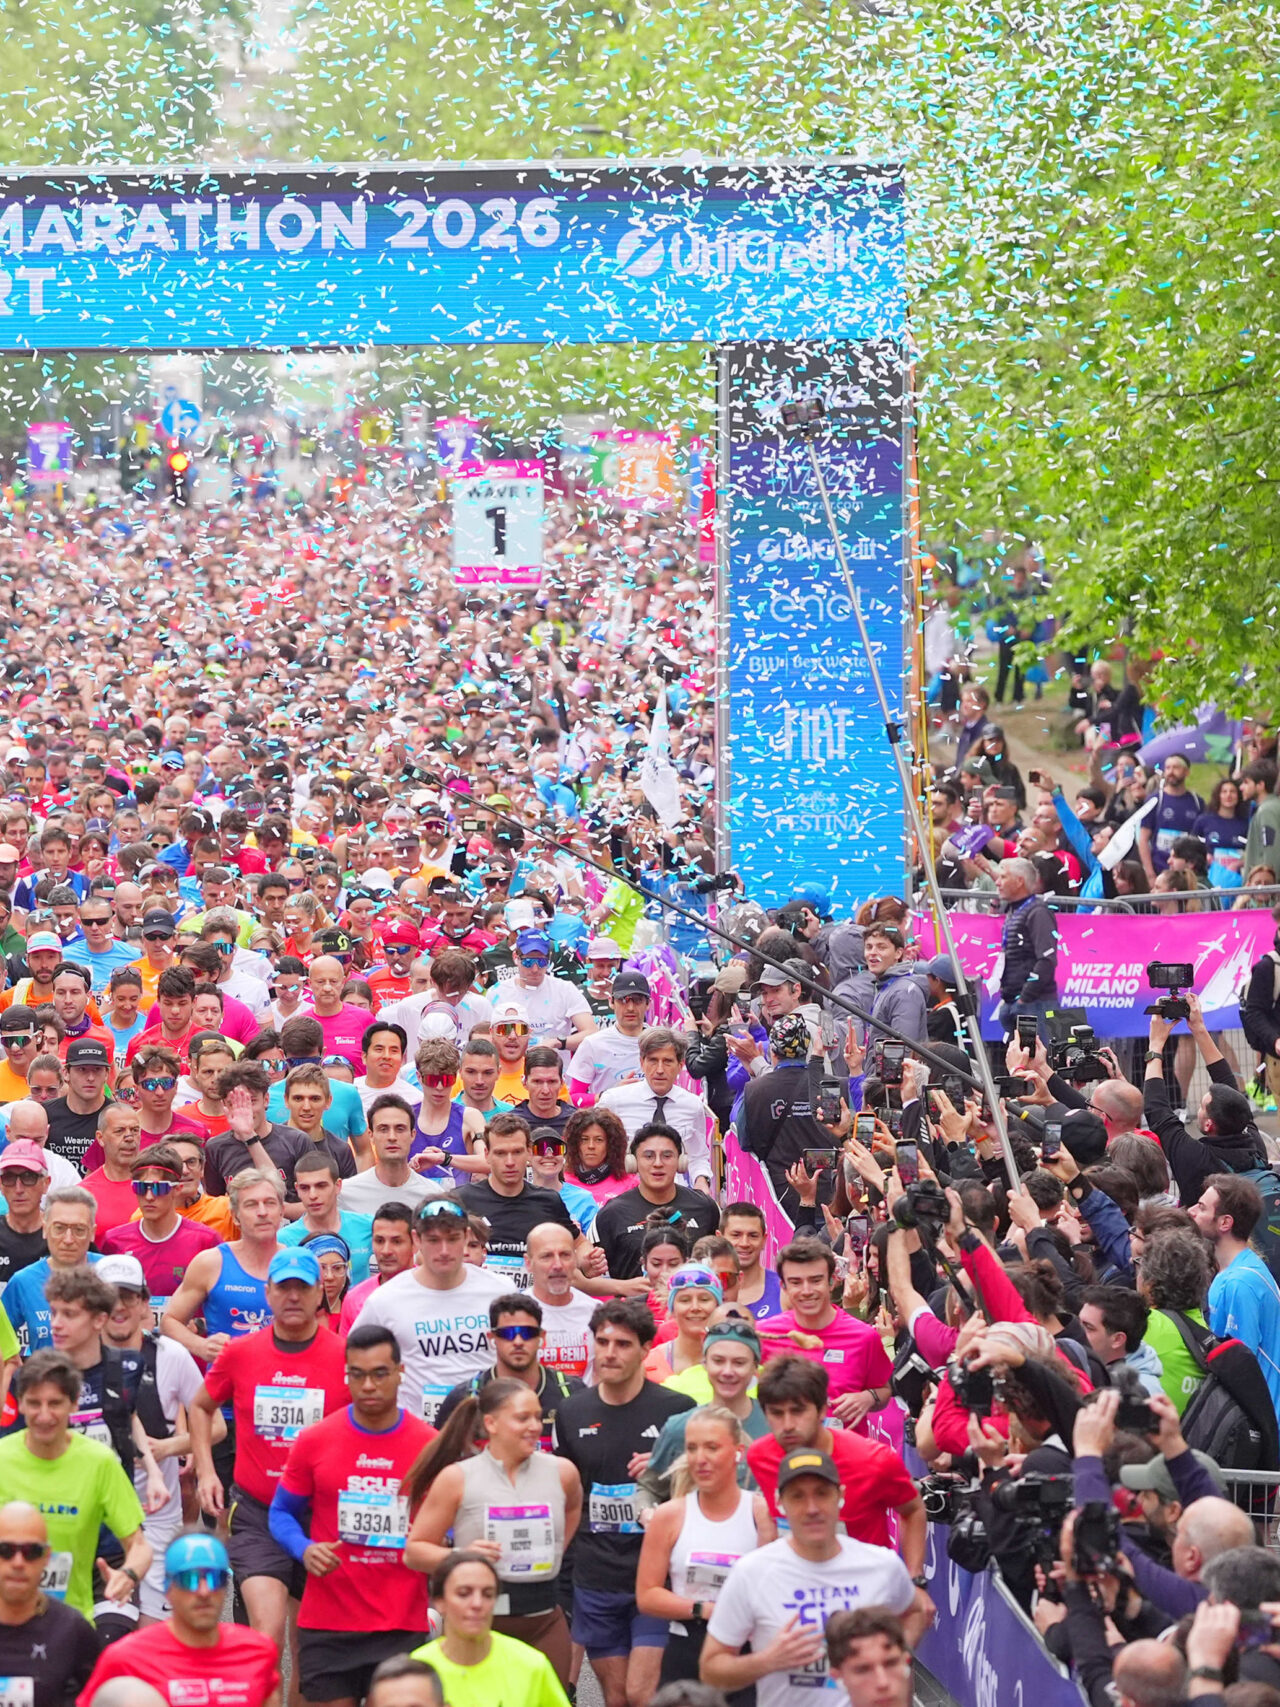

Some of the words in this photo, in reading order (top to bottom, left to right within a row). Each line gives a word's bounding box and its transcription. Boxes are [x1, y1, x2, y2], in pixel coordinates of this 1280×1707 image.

[392, 197, 560, 251] 2026
[467, 485, 521, 499] WAVE
[485, 506, 507, 555] 1
[783, 708, 852, 761] FIAT
[1071, 963, 1115, 978] WIZZ
[1116, 963, 1144, 977] AIR
[1064, 979, 1141, 996] MILANO
[1060, 996, 1135, 1009] MARATHON
[223, 1284, 257, 1294] macron
[414, 1320, 452, 1337] RUN
[454, 1314, 490, 1332] FOR
[418, 1332, 490, 1358] WASA
[560, 1346, 587, 1362] CENA
[270, 1406, 305, 1427] 331A
[600, 1503, 634, 1522] 3010
[353, 1511, 392, 1534] 333A
[809, 1585, 860, 1599] TEAM
